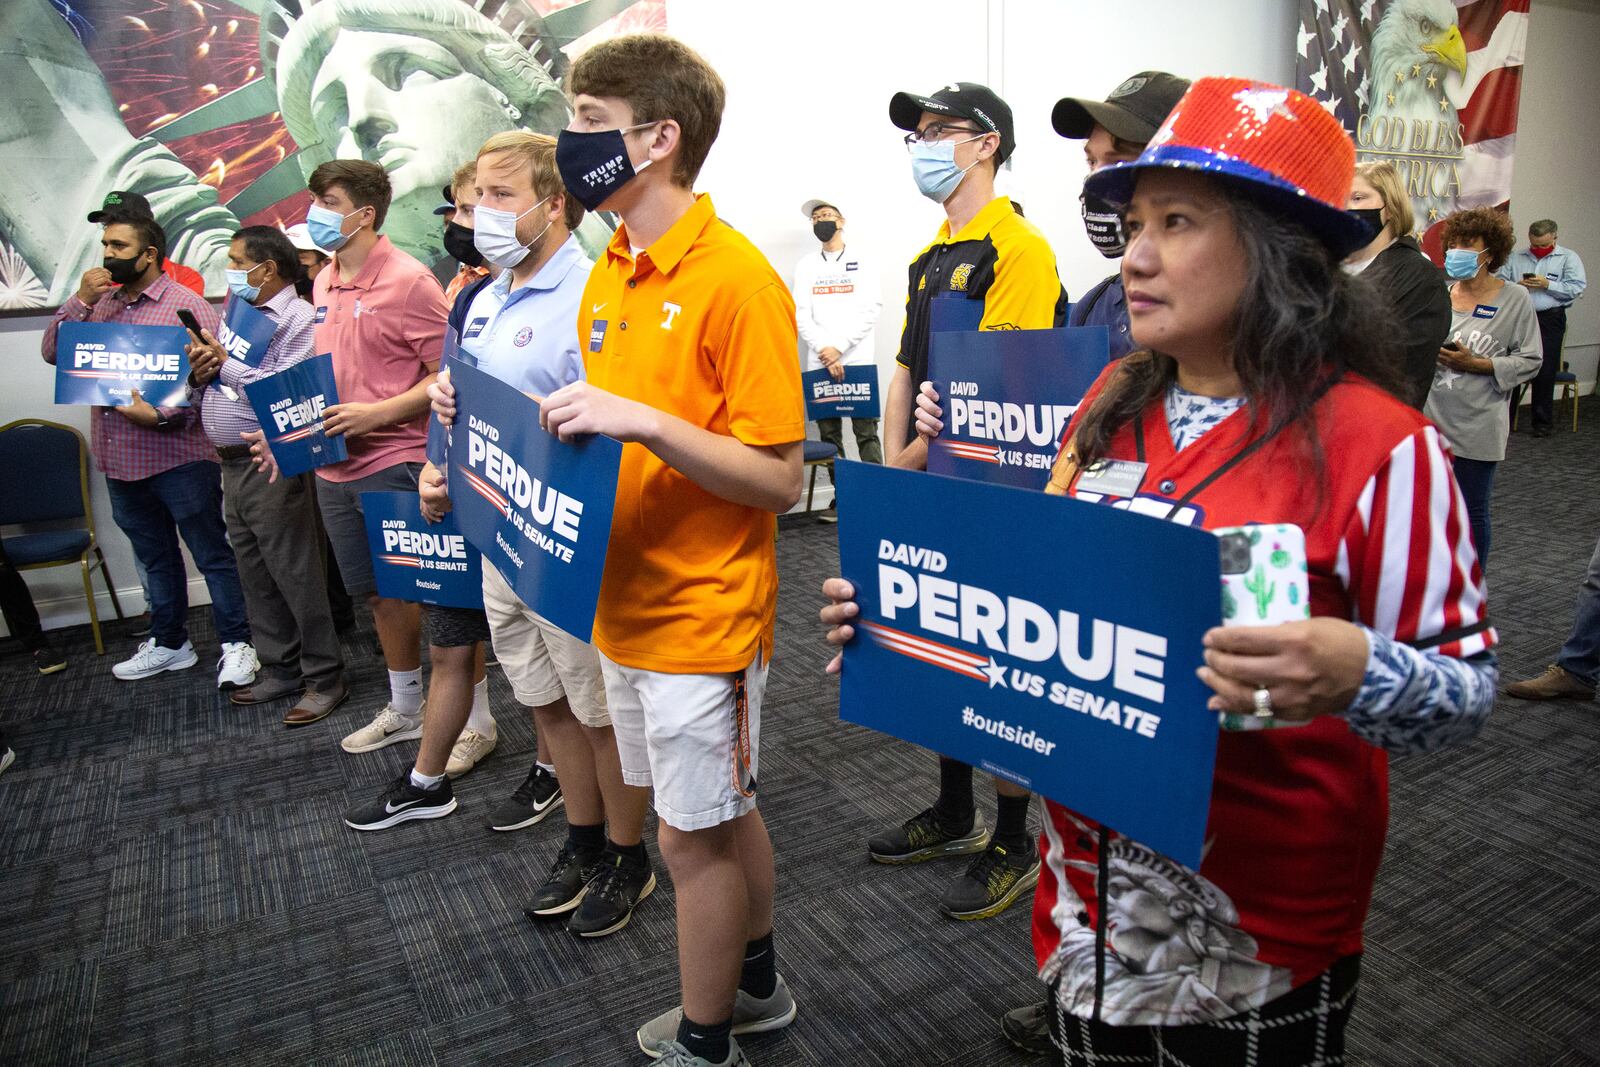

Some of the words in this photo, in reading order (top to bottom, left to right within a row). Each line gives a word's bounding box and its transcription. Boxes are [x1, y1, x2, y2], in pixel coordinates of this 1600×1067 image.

[1357, 113, 1407, 149] GOD
[1413, 119, 1465, 153] BLESS
[582, 155, 623, 183] TRUMP
[590, 164, 624, 187] PENCE
[604, 176, 616, 185] 2020
[1087, 222, 1108, 232] Class
[1092, 235, 1115, 243] 2020
[831, 285, 853, 293] TRUMP
[660, 301, 682, 330] T
[219, 325, 252, 361] DUE
[74, 351, 180, 372] PERDUE
[813, 383, 871, 398] PERDUE
[950, 381, 979, 396] DAVID
[270, 398, 293, 412] DAVID
[468, 414, 500, 442] DAVID
[1007, 451, 1023, 466] US
[1024, 453, 1056, 470] SEN
[468, 430, 584, 543] PERDUE
[382, 520, 407, 529] DAVID
[383, 530, 467, 558] PERDUE
[496, 530, 524, 569] #outsider
[513, 513, 525, 531] US
[524, 524, 575, 564] SENATE
[425, 561, 435, 569] US
[435, 562, 468, 571] SENATE
[878, 538, 948, 573] DAVID
[416, 579, 441, 590] #outsider
[877, 563, 1168, 703] PERDUE
[1011, 668, 1046, 694] US
[1048, 681, 1161, 739] SENATE
[961, 706, 1056, 757] #outsider
